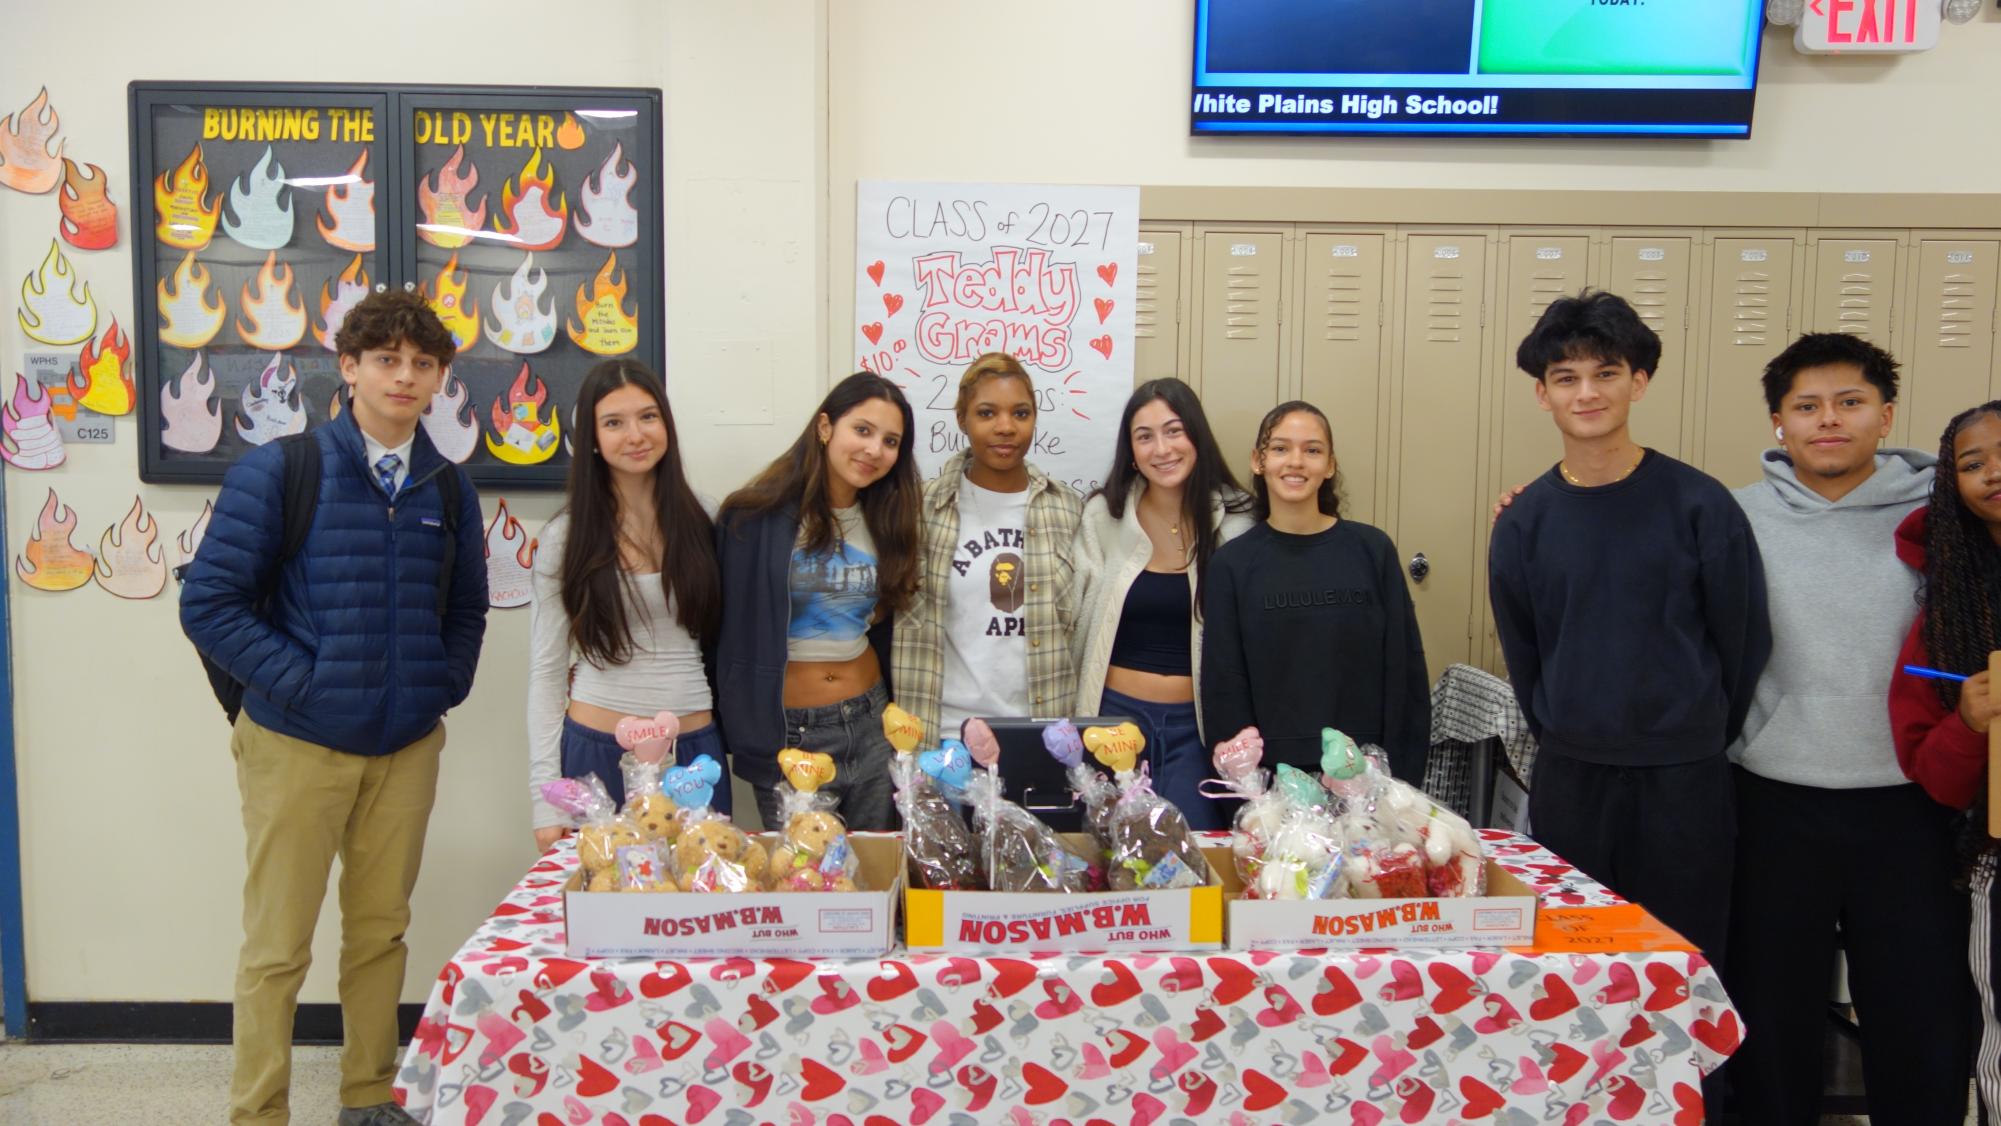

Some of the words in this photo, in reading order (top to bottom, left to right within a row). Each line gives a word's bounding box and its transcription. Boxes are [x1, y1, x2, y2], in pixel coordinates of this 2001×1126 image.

[1259, 94, 1333, 113] Plains
[1341, 95, 1398, 118] High
[1405, 95, 1498, 114] School!
[203, 108, 320, 141] BURNING
[328, 109, 375, 142] THE
[415, 111, 472, 145] OLD
[479, 113, 555, 148] YEAR
[886, 196, 989, 242] CLASS
[997, 211, 1020, 234] of
[1026, 202, 1114, 250] 2027
[914, 247, 1080, 327] Teddy
[917, 312, 1070, 370] Grams
[30, 357, 58, 365] WPHS
[77, 428, 109, 440] C125
[627, 726, 666, 744] SMILE
[675, 778, 705, 797] YOU
[775, 928, 799, 937] WHO
[1410, 925, 1429, 934] BUT
[1431, 923, 1454, 933] WHO
[751, 930, 772, 939] BUT
[1107, 931, 1134, 942] BUT
[1139, 929, 1172, 941] WHO
